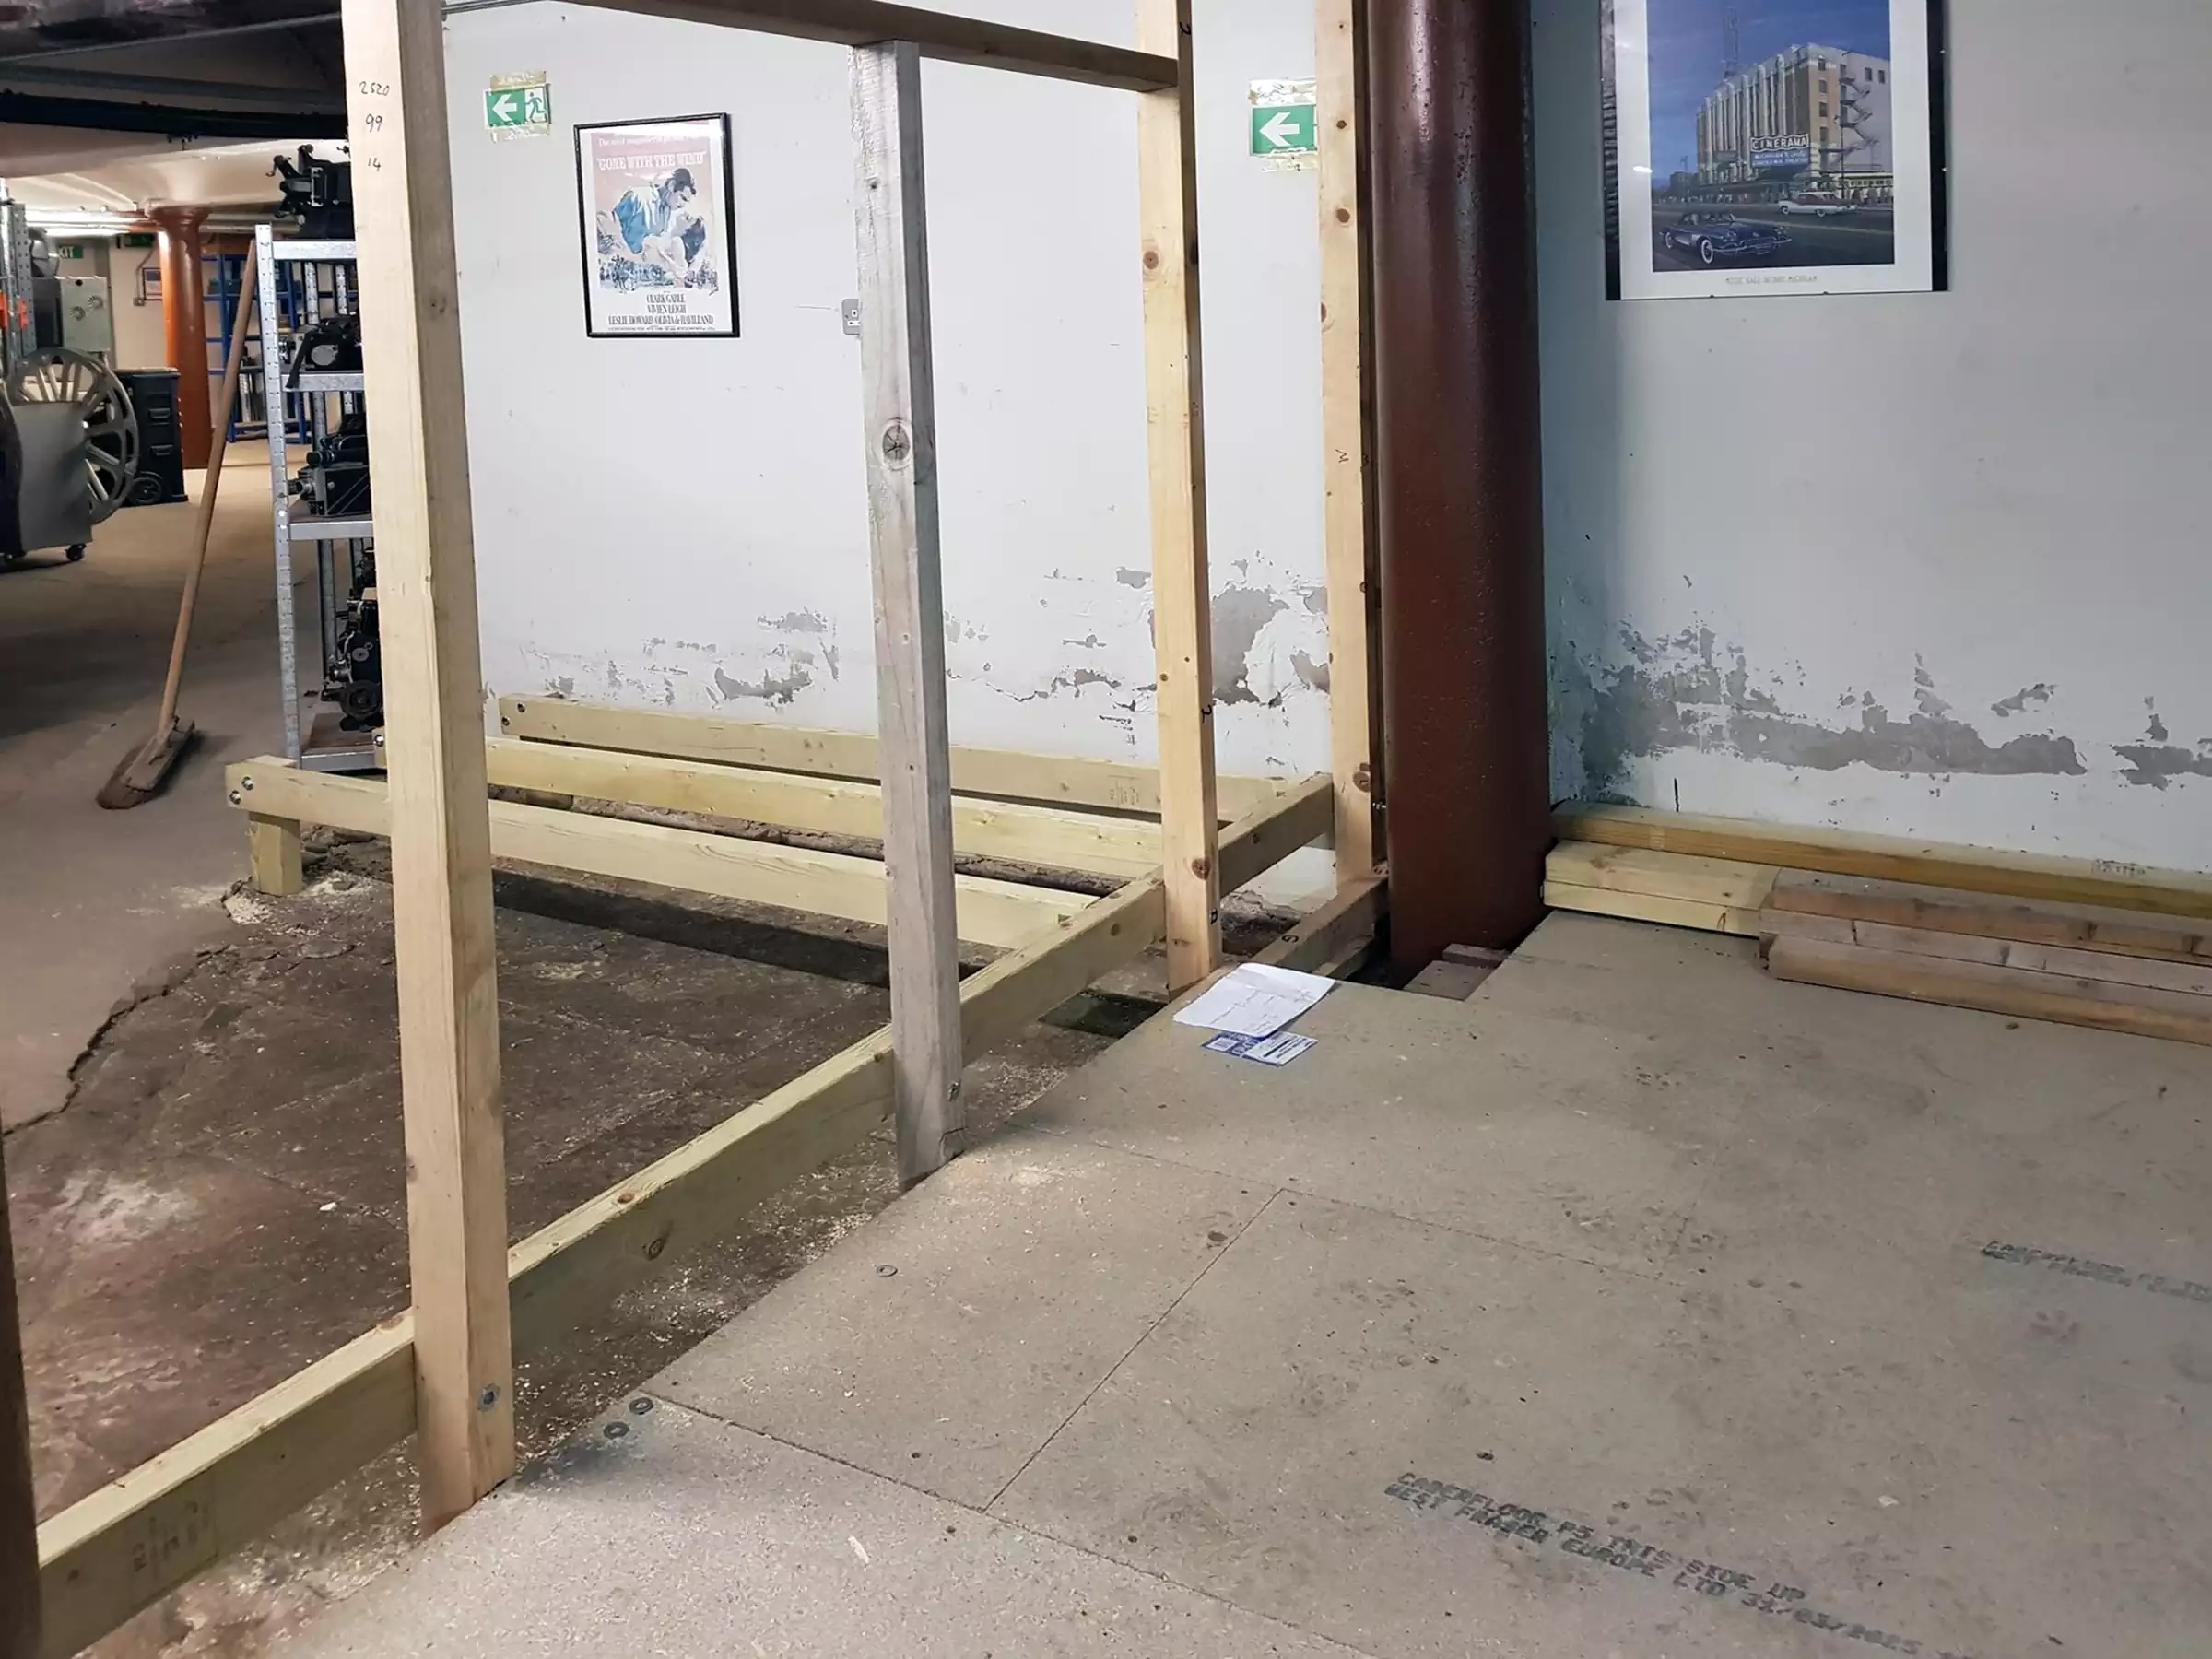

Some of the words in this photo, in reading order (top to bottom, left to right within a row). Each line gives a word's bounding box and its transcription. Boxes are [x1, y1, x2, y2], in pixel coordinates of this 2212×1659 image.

[359, 81, 391, 96] 2520
[365, 113, 383, 133] 99
[1752, 137, 1807, 149] CINERAMA
[367, 157, 382, 171] 14
[653, 154, 676, 168] THE
[1383, 1482, 1441, 1512] WEST
[1454, 1505, 1549, 1545] FRASER
[1560, 1536, 1665, 1578] EUROPE
[1673, 1571, 1727, 1596] LTD
[1556, 1521, 1594, 1539] P5
[1684, 1559, 1756, 1589] SIDE
[1767, 1582, 1806, 1602] UP
